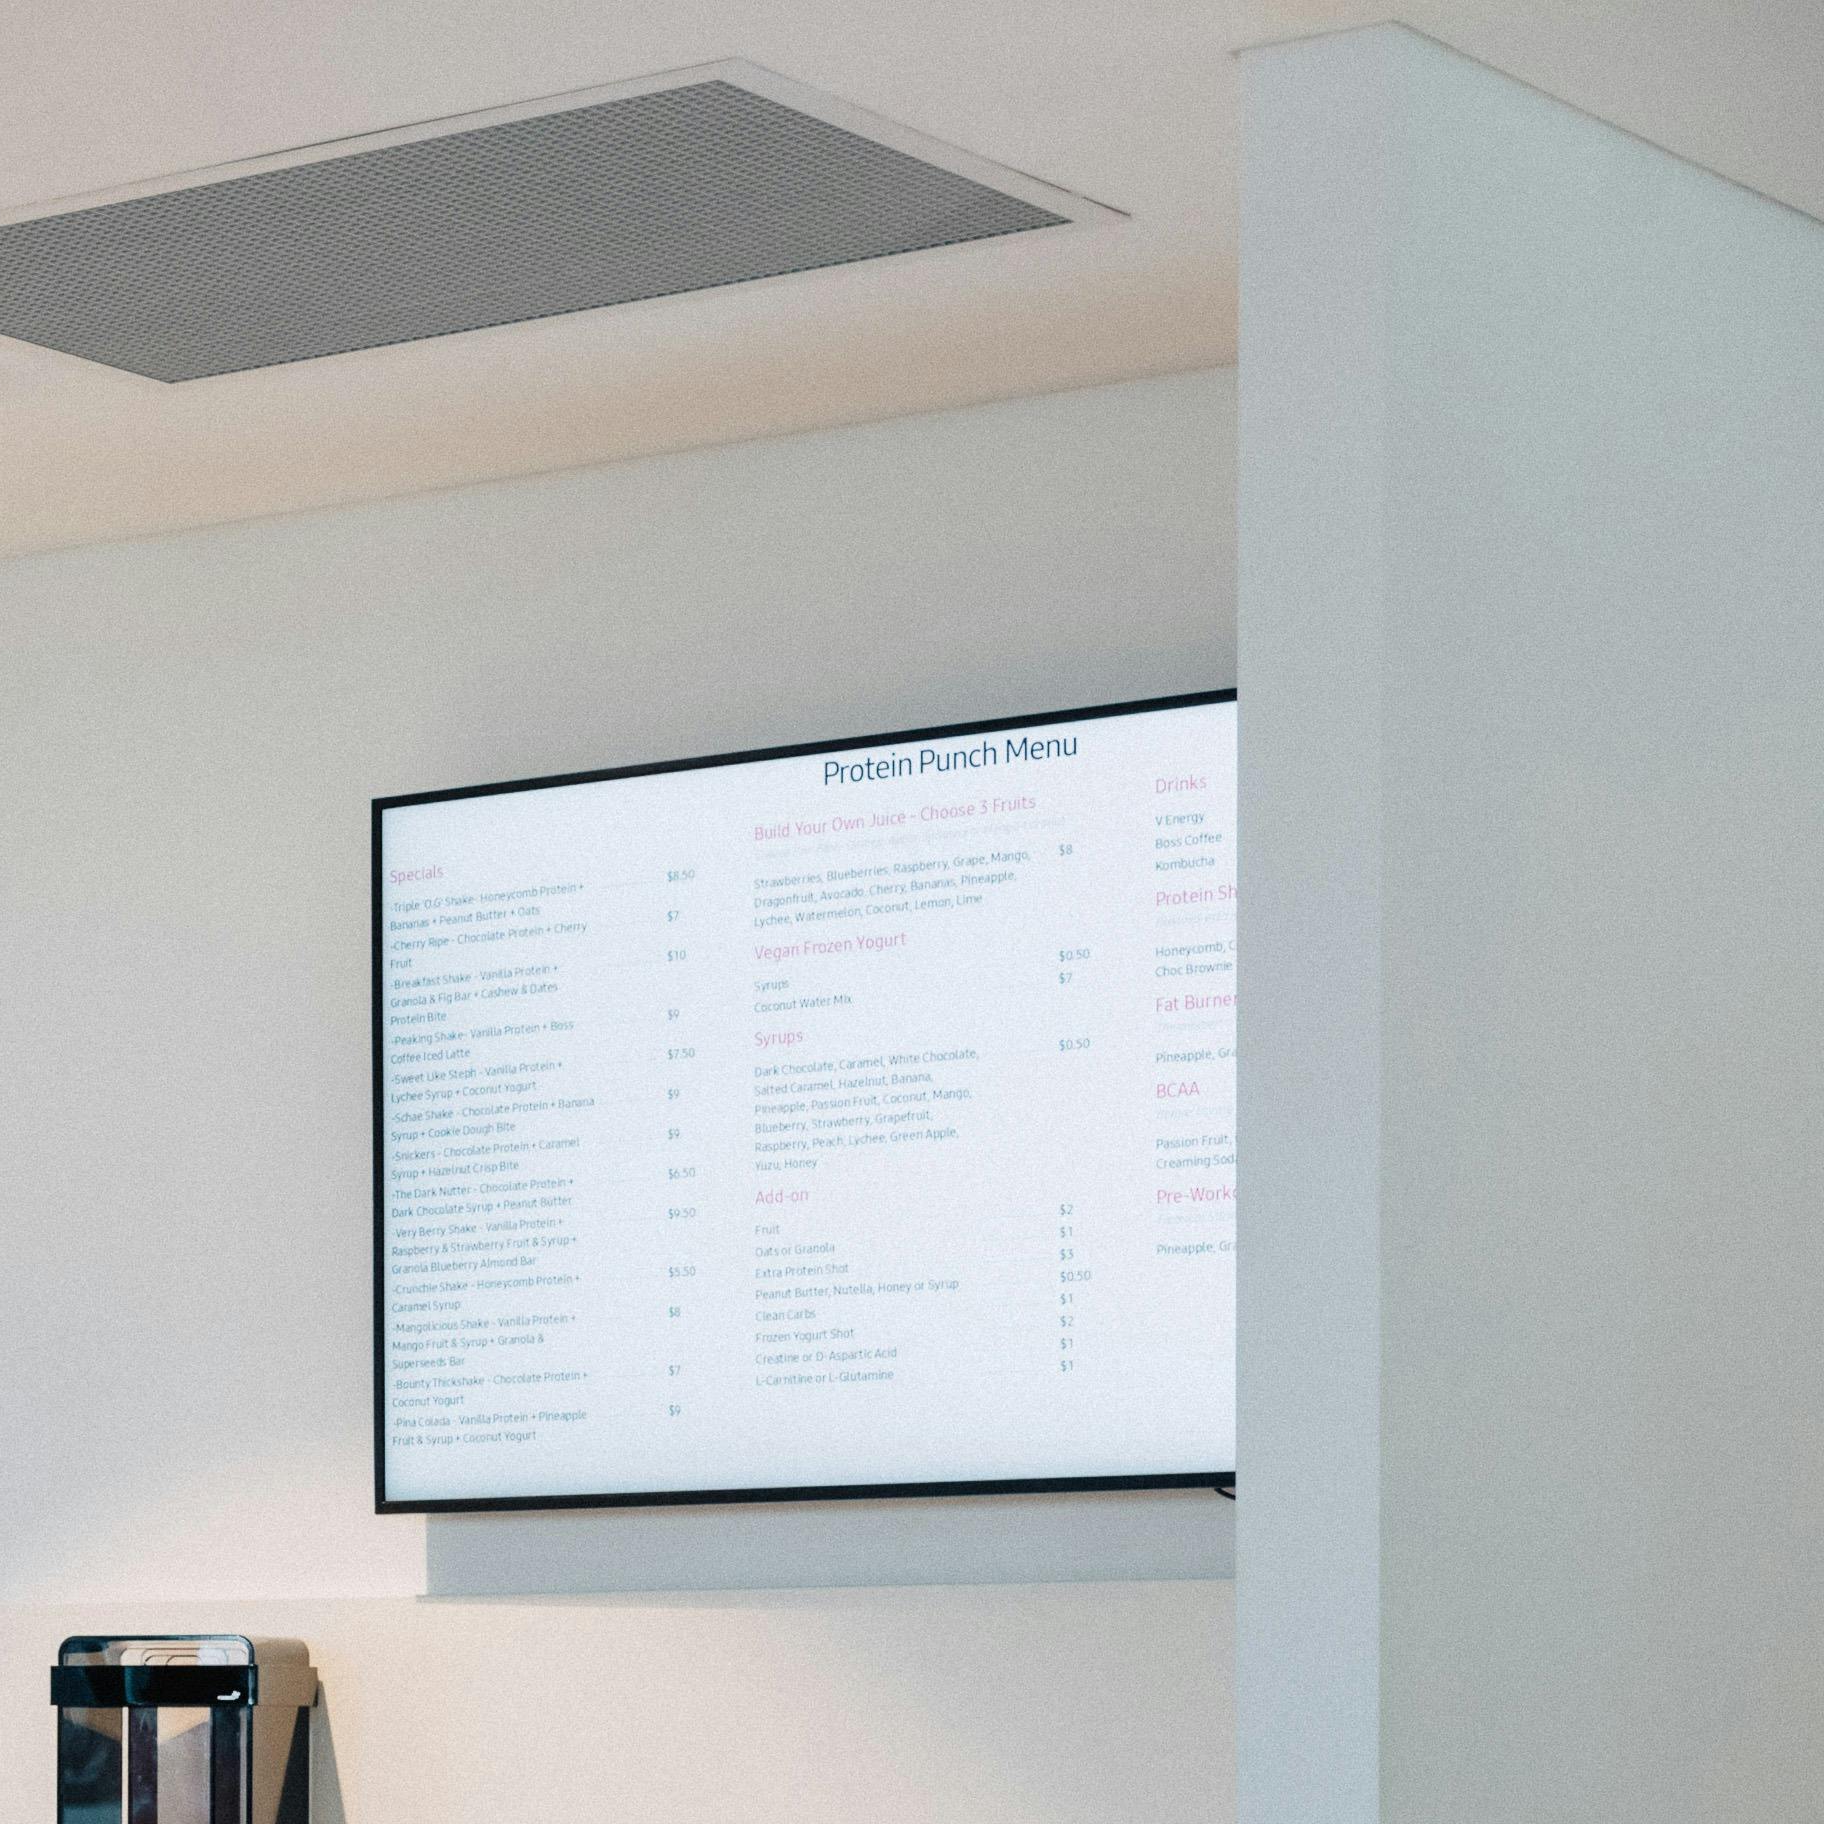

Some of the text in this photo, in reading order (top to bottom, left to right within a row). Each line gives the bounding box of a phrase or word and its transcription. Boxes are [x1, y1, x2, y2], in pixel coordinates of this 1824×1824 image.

[824, 737, 1077, 785] Protein Punch Menu
[1157, 775, 1205, 792] Drinks
[755, 823, 788, 839] Build
[796, 822, 825, 834] Your
[833, 818, 863, 830] Own
[870, 812, 905, 826] Juice
[921, 806, 974, 820] Choose
[981, 800, 986, 813] 3
[994, 791, 1037, 811] Fruits
[391, 865, 442, 884] Specials
[755, 933, 905, 961] Vegan Frozen Yogurt
[754, 980, 788, 991] Syrups
[755, 1032, 802, 1047] Syrups
[1157, 1082, 1198, 1097] BCAA
[1212, 1154, 1233, 1164] Sod
[756, 1190, 808, 1203] Add-on
